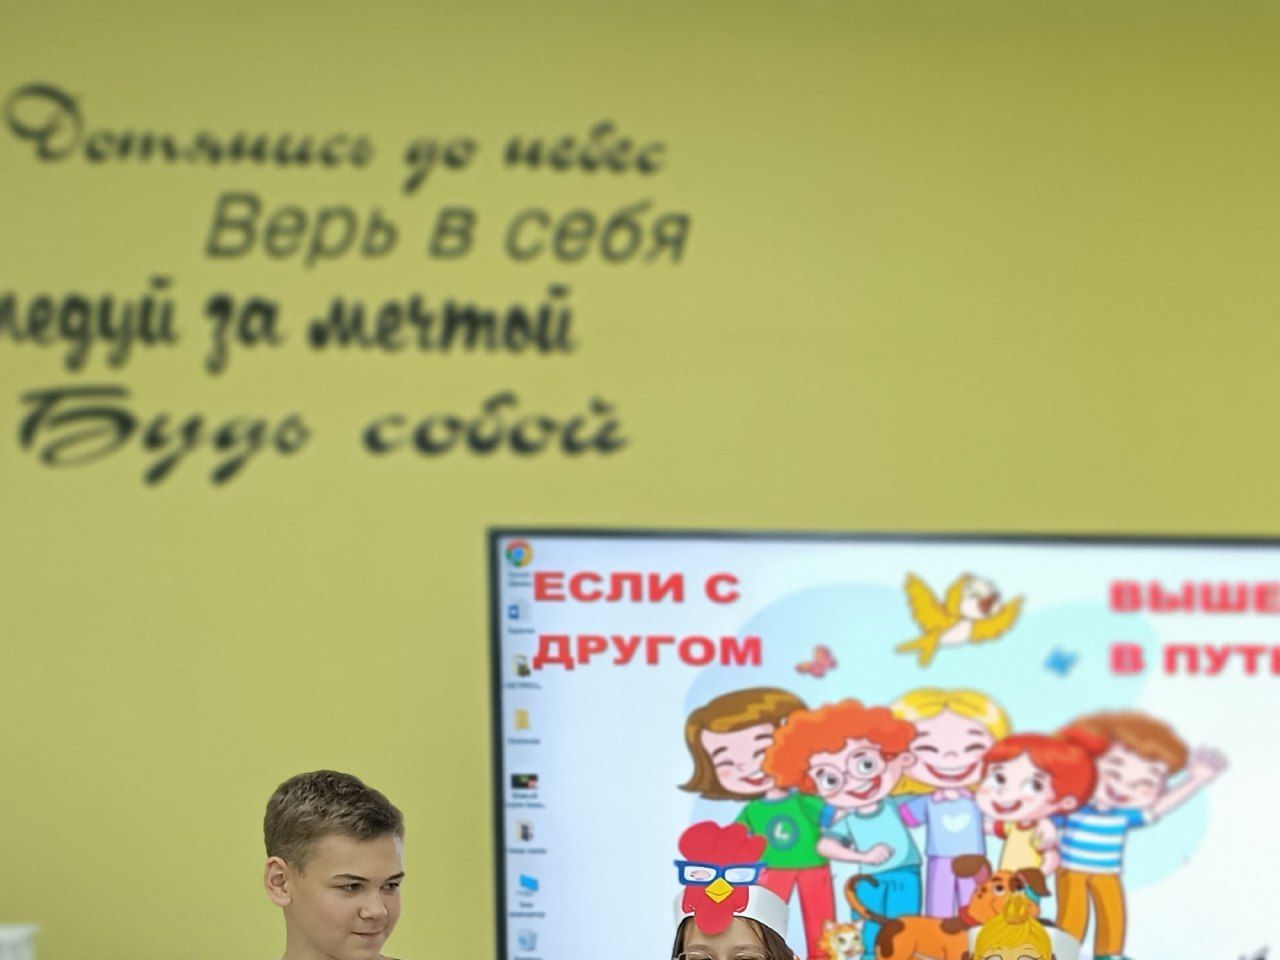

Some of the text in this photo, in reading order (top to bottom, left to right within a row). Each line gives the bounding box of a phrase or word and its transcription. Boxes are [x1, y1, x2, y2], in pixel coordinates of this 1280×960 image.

[205, 191, 690, 268] Верь в себя
[205, 292, 285, 375] за
[309, 283, 578, 355] мечтой
[20, 385, 628, 486] Будь собой
[534, 571, 684, 603] ЕСЛИ
[704, 573, 740, 604] С
[533, 634, 762, 670] ДРУГОМ
[1110, 643, 1145, 675] В
